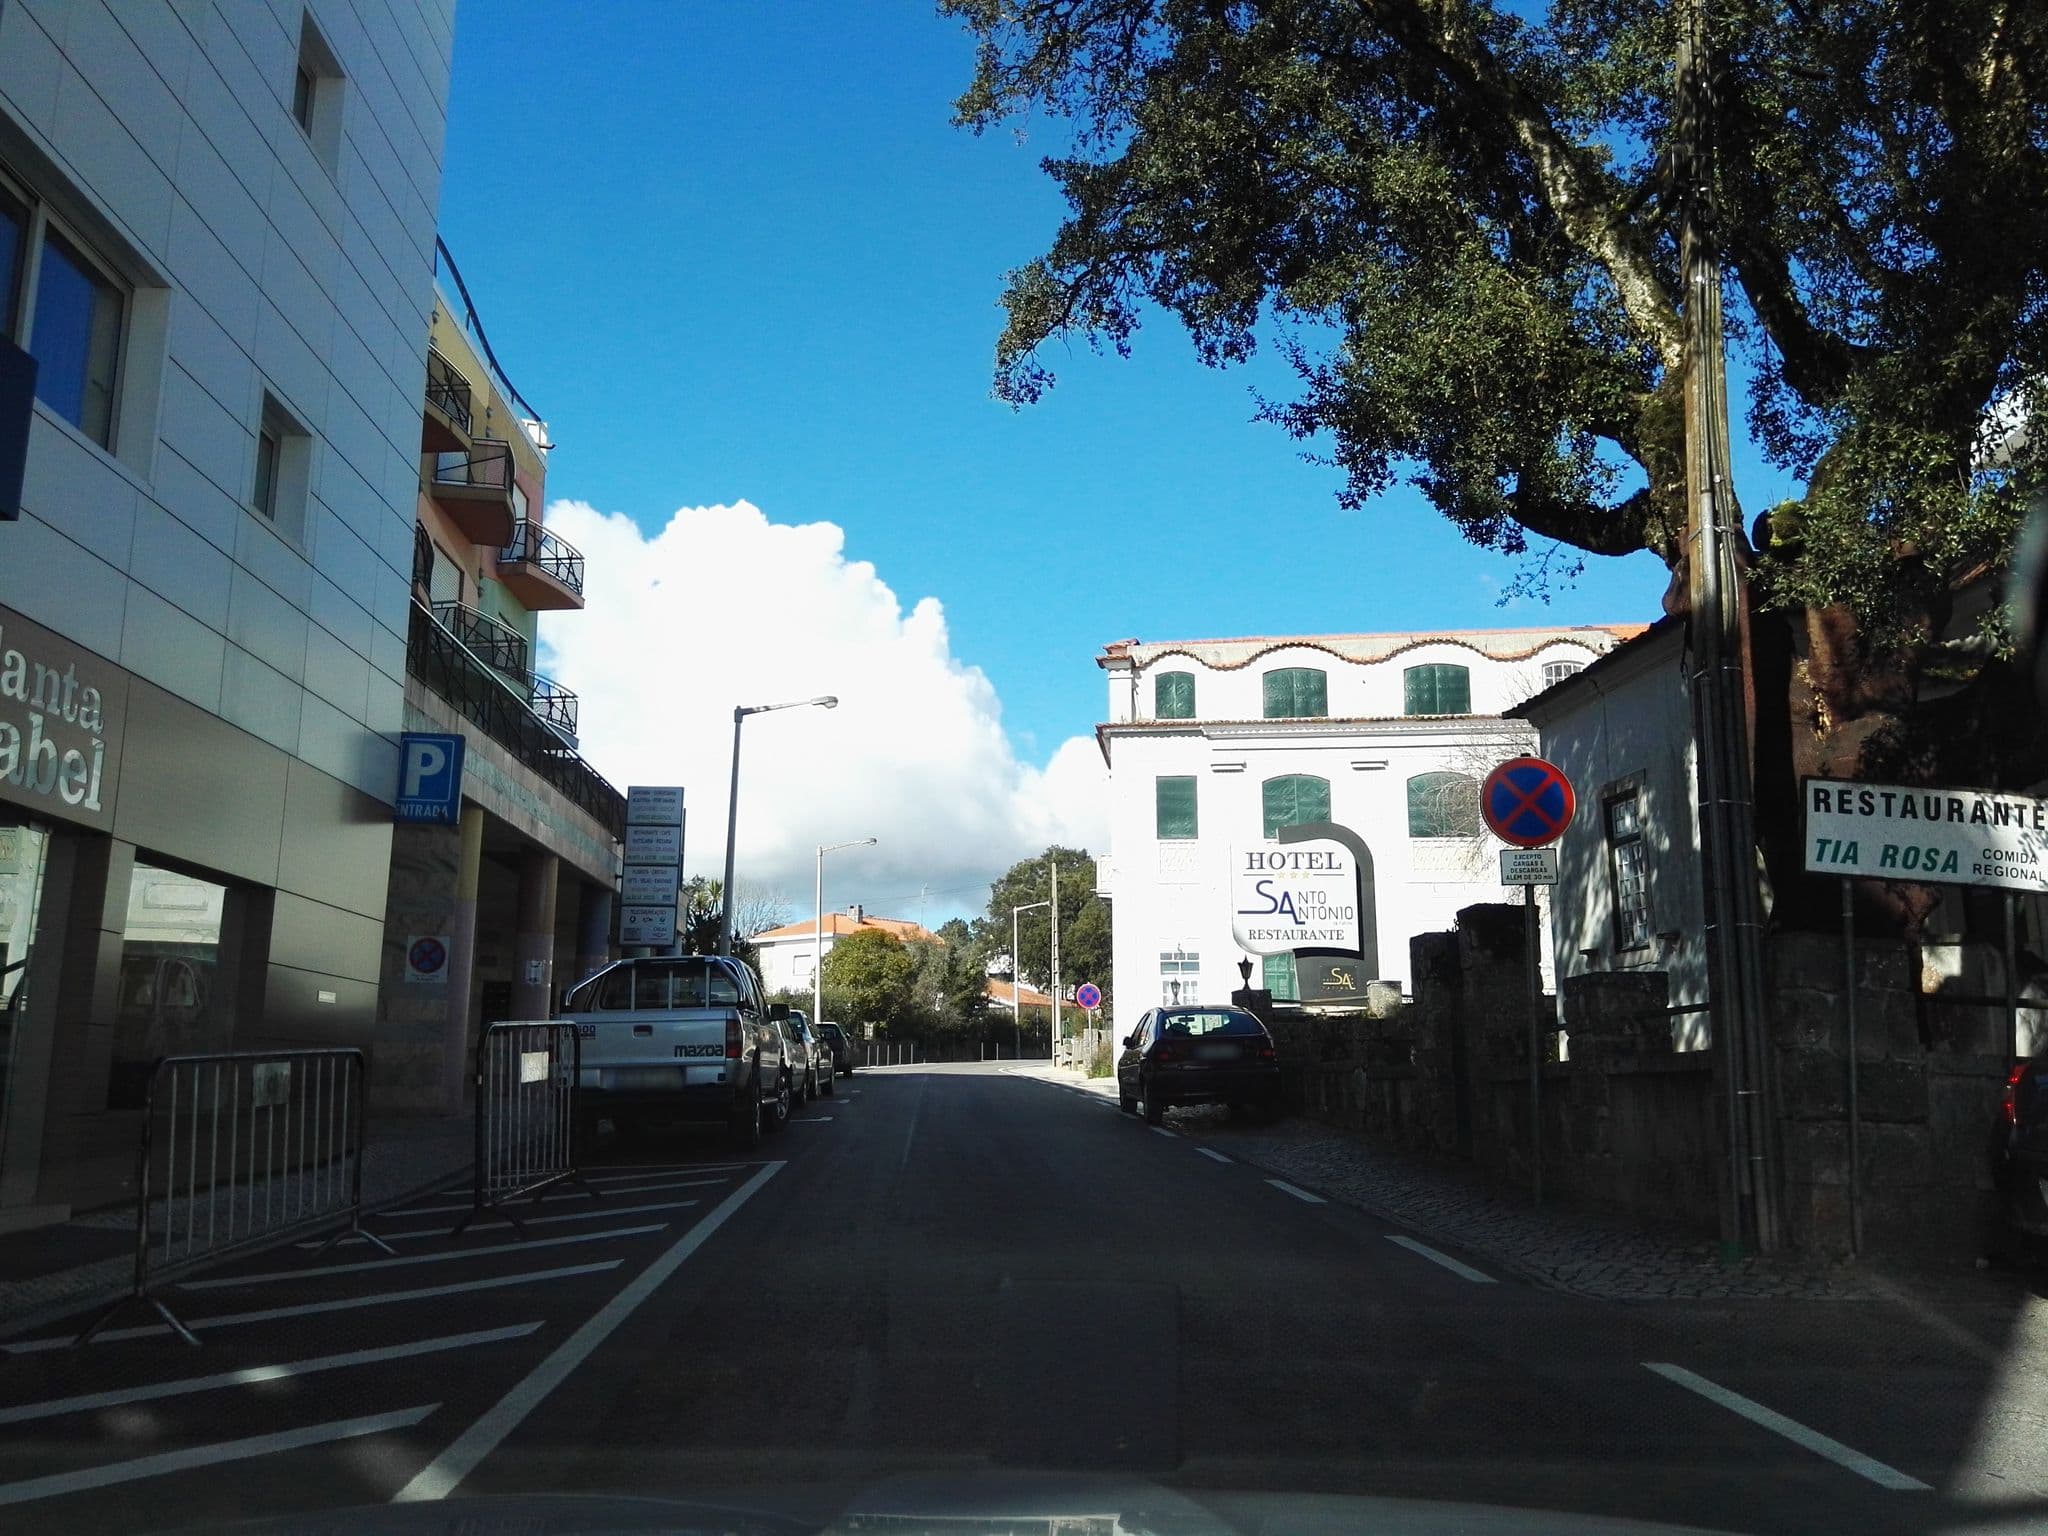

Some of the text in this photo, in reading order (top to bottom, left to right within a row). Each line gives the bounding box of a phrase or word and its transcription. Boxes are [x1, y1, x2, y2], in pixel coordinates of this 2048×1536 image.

[405, 743, 445, 796] P
[1813, 788, 2046, 830] RESTAURANTE
[1245, 851, 1342, 870] HOTEL
[1816, 838, 1959, 874] TIA ROSA
[1982, 848, 2039, 866] COMIDA
[1972, 863, 2046, 882] REGIONAL
[1248, 929, 1345, 940] RESTAURANTE
[674, 1044, 724, 1058] mazda
